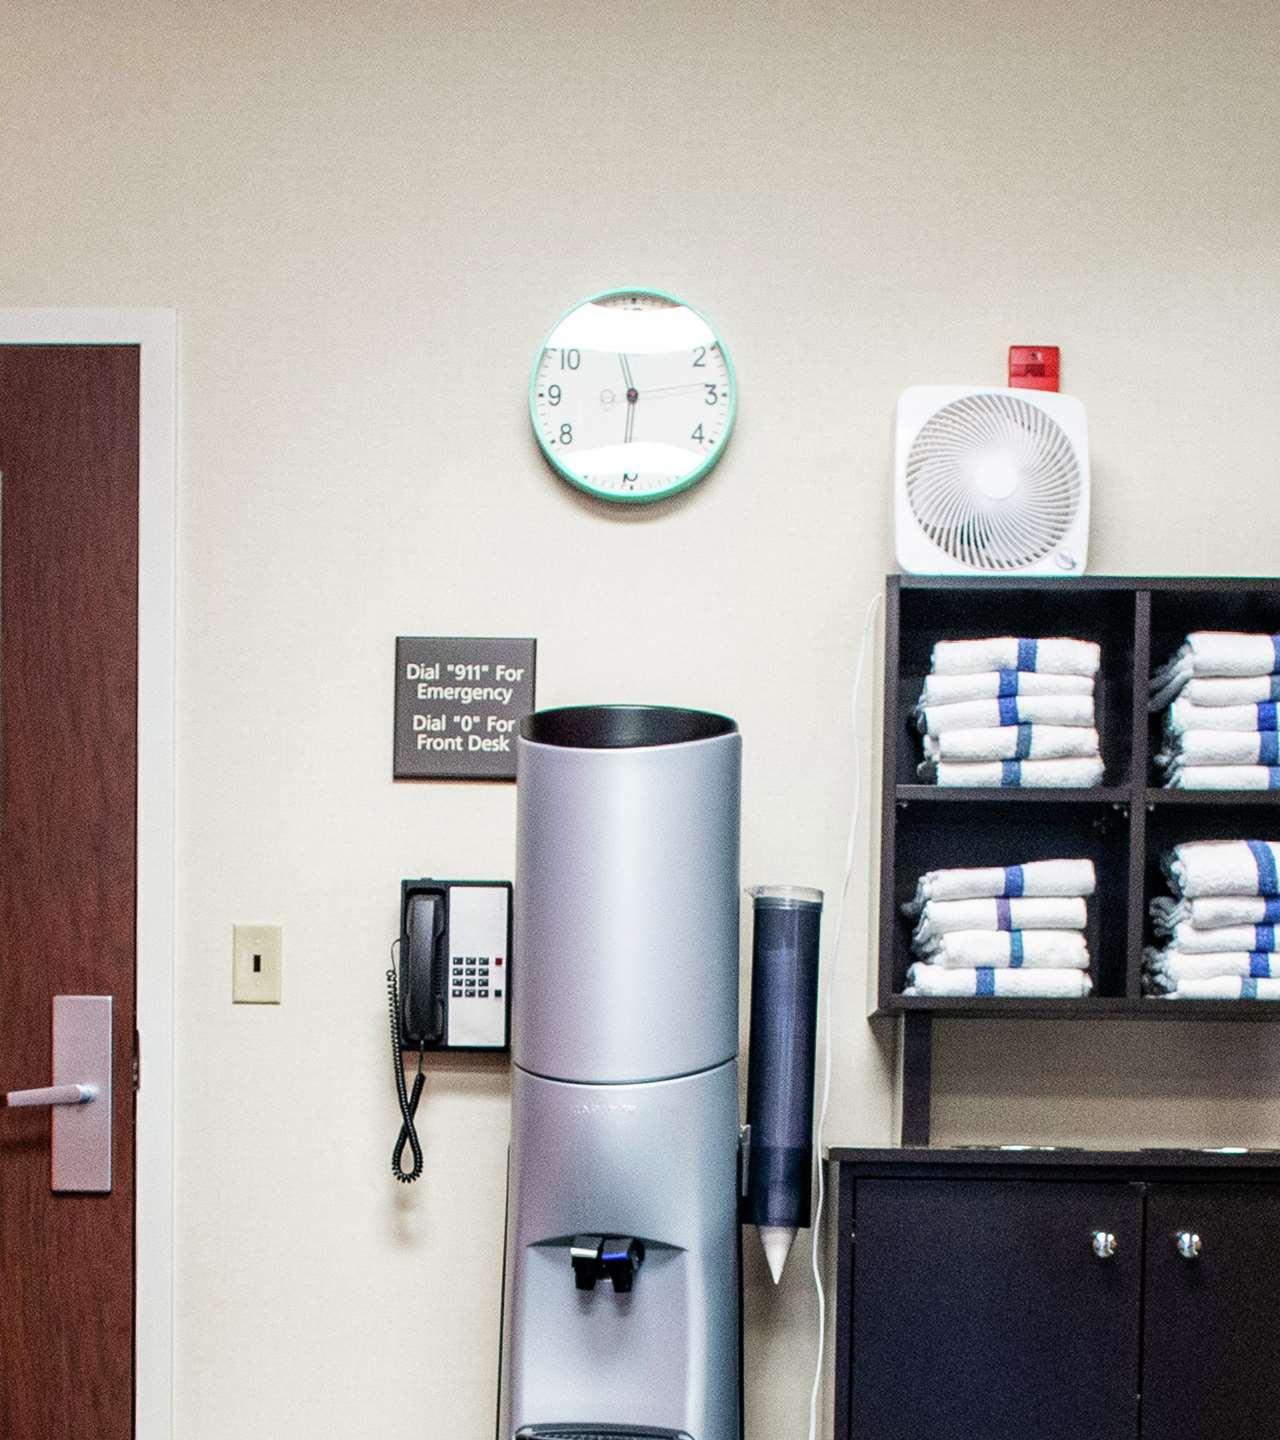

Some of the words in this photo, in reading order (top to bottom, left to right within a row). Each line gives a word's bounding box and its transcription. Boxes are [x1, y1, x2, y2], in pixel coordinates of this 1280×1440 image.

[560, 348, 581, 370] 10
[693, 346, 706, 367] 2
[548, 384, 562, 406] 9
[705, 384, 718, 406] 3
[559, 423, 573, 445] 8
[691, 423, 705, 444] 4
[406, 663, 440, 680] Dial
[447, 664, 489, 681] "911"
[495, 665, 525, 682] For
[417, 683, 513, 704] Emergency
[412, 714, 446, 731] Dial
[453, 715, 480, 732] "0"
[487, 716, 516, 733] For
[417, 734, 467, 751] Front
[468, 735, 511, 751] Desk
